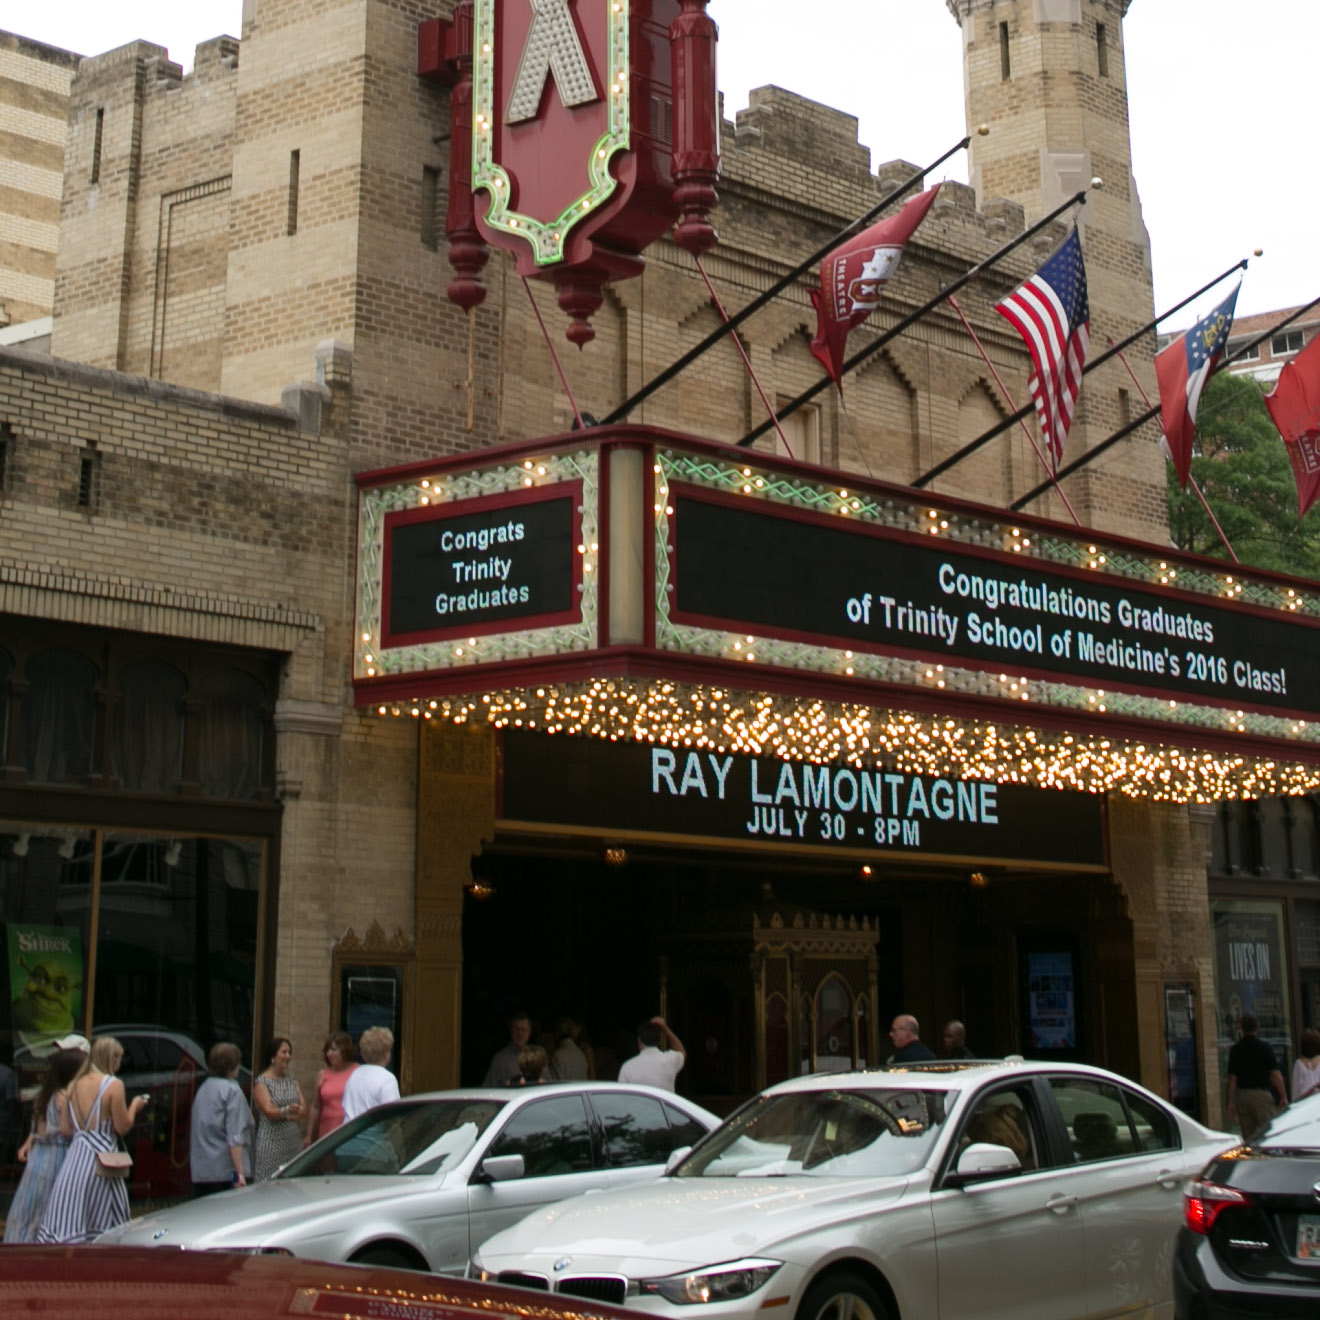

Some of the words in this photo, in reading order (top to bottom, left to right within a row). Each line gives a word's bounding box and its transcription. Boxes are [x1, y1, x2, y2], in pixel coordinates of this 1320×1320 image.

[837, 258, 847, 315] THEATRE
[440, 520, 525, 553] Congrats
[452, 557, 512, 584] Trinity
[435, 583, 530, 615] Graduates
[938, 562, 1112, 624] Congratulations
[1117, 598, 1214, 644] Graduates
[846, 594, 872, 623] of
[880, 596, 959, 646] Trinity
[967, 612, 1043, 654] School
[1050, 630, 1072, 659] of
[1078, 632, 1181, 677] Medicine's
[1186, 651, 1228, 685] 2016
[1233, 660, 1287, 694] Class!
[651, 747, 733, 799] RAY
[751, 759, 999, 824] LAMONTAGNE
[746, 806, 808, 837] JULY
[820, 812, 846, 841] 30
[874, 818, 921, 847] 8PM
[1228, 941, 1256, 981] LIVES
[1256, 942, 1271, 981] ON
